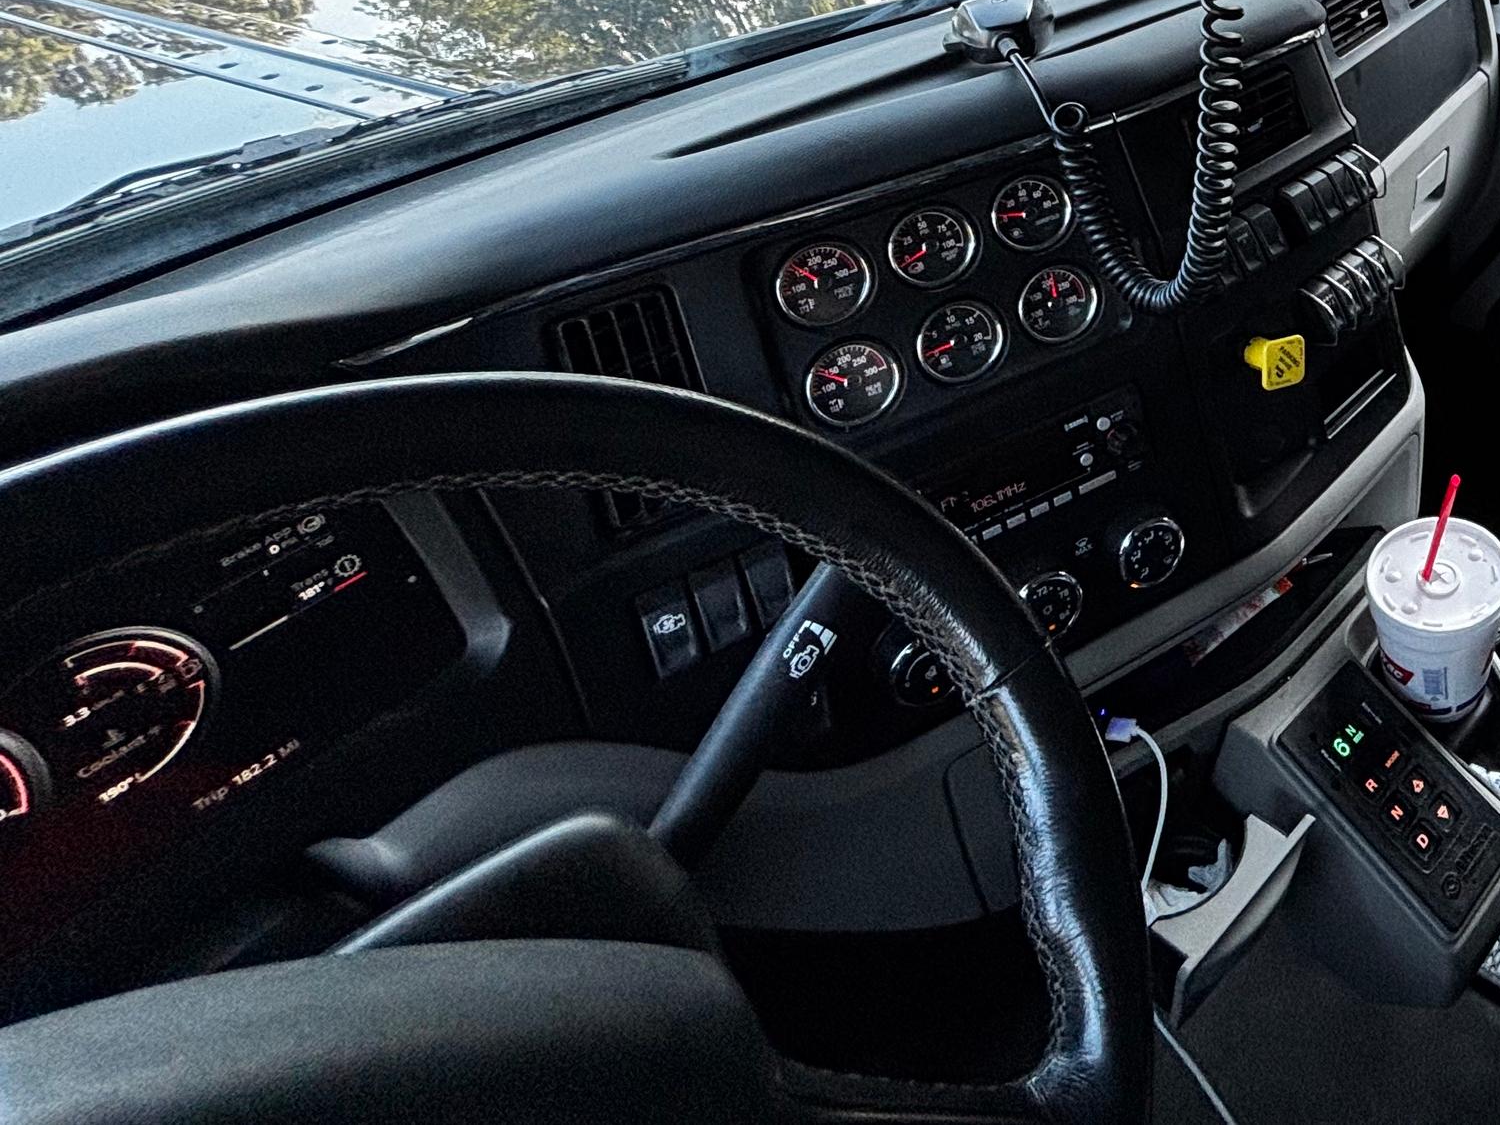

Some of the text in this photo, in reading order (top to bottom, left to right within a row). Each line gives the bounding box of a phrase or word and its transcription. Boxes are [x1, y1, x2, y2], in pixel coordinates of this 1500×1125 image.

[806, 255, 822, 266] 200
[822, 258, 838, 269] 250
[833, 268, 849, 279] 300
[792, 283, 806, 293] 100
[836, 353, 852, 366] 200
[852, 355, 867, 367] 250
[825, 365, 840, 376] 150
[863, 365, 878, 377] 300
[821, 382, 836, 394] 100
[1074, 542, 1095, 556] MAX
[290, 569, 330, 591] Trans
[1036, 586, 1048, 597] 72
[782, 632, 801, 659] OFF
[1345, 724, 1357, 737] N
[1333, 738, 1351, 758] 6
[76, 734, 146, 779] Coolant
[191, 785, 231, 811] Trip
[231, 753, 278, 786] 182.2
[1364, 778, 1379, 793] R
[1389, 805, 1405, 821] N
[1415, 833, 1430, 850] D
